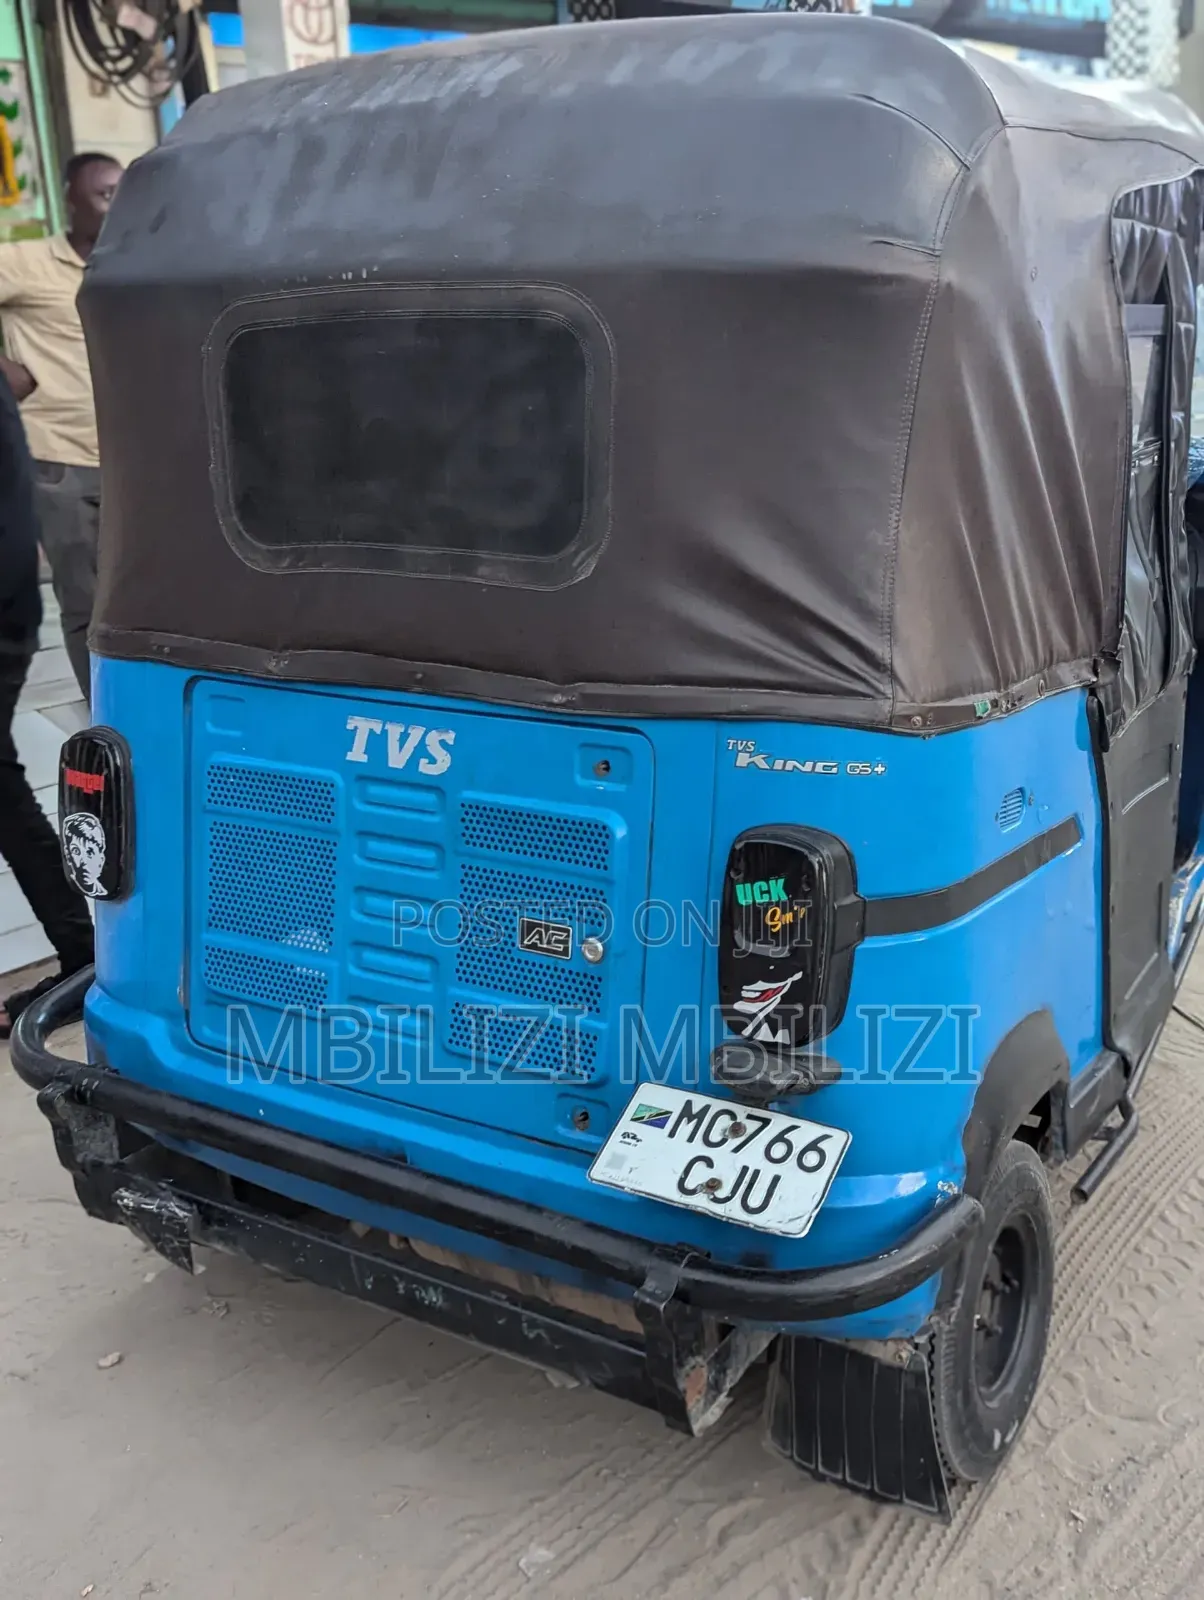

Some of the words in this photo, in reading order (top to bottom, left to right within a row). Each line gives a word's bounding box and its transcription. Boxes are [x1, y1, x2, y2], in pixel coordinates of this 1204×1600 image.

[345, 715, 456, 776] TVS
[726, 738, 756, 752] TVS
[667, 1099, 833, 1173] MC766
[677, 1155, 782, 1215] CJU
